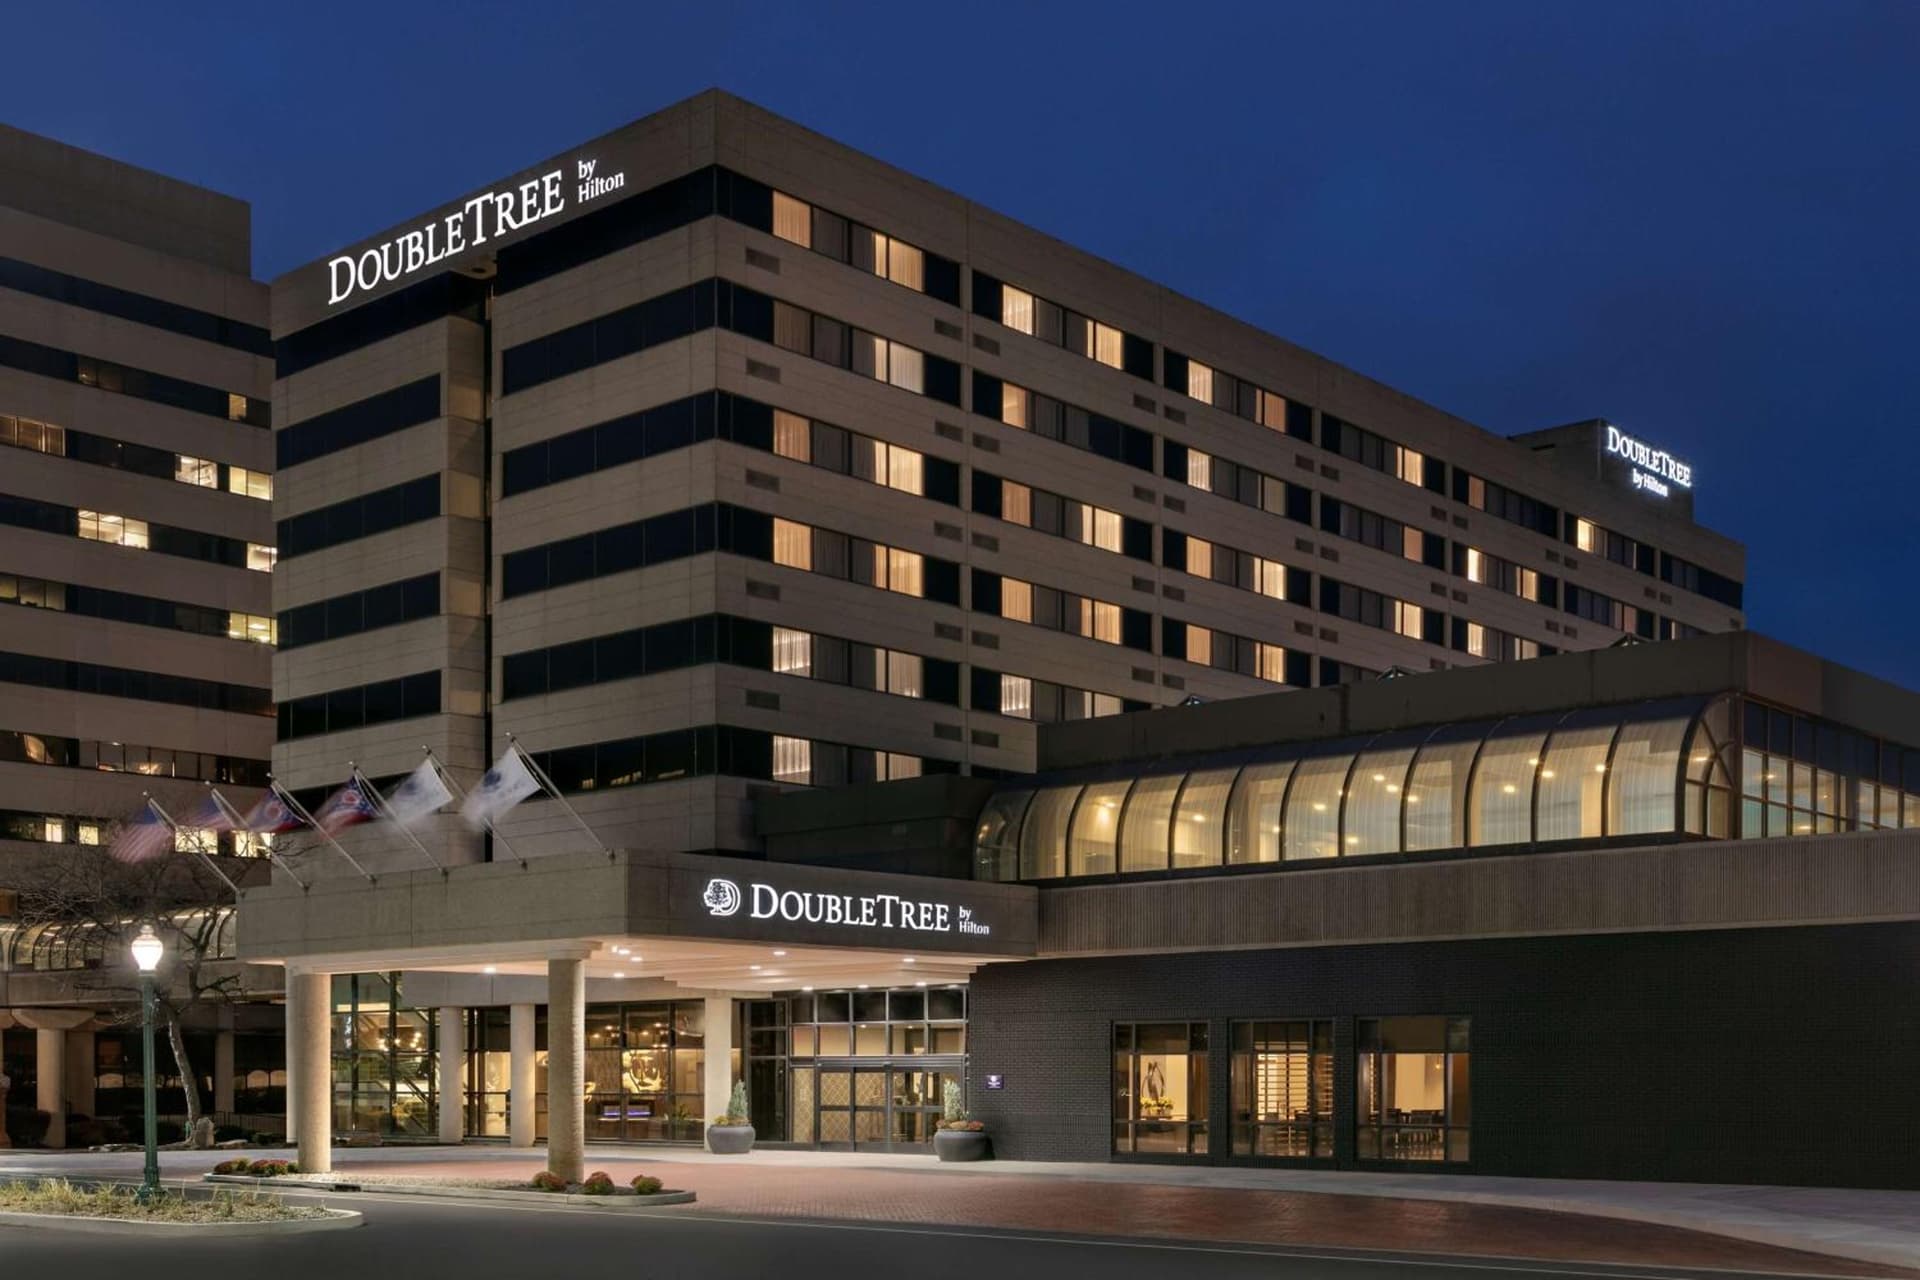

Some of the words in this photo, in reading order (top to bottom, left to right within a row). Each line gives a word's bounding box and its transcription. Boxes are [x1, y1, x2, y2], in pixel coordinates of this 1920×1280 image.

[578, 159, 597, 182] by
[578, 172, 625, 203] Hilton
[328, 170, 565, 305] DOUBLETREE
[1607, 426, 1692, 488] DOUBLETREE
[1633, 468, 1644, 489] by
[1644, 473, 1669, 497] Hilton
[750, 884, 951, 932] DOUBLETREE
[959, 906, 972, 919] by
[959, 920, 990, 936] Hilton
